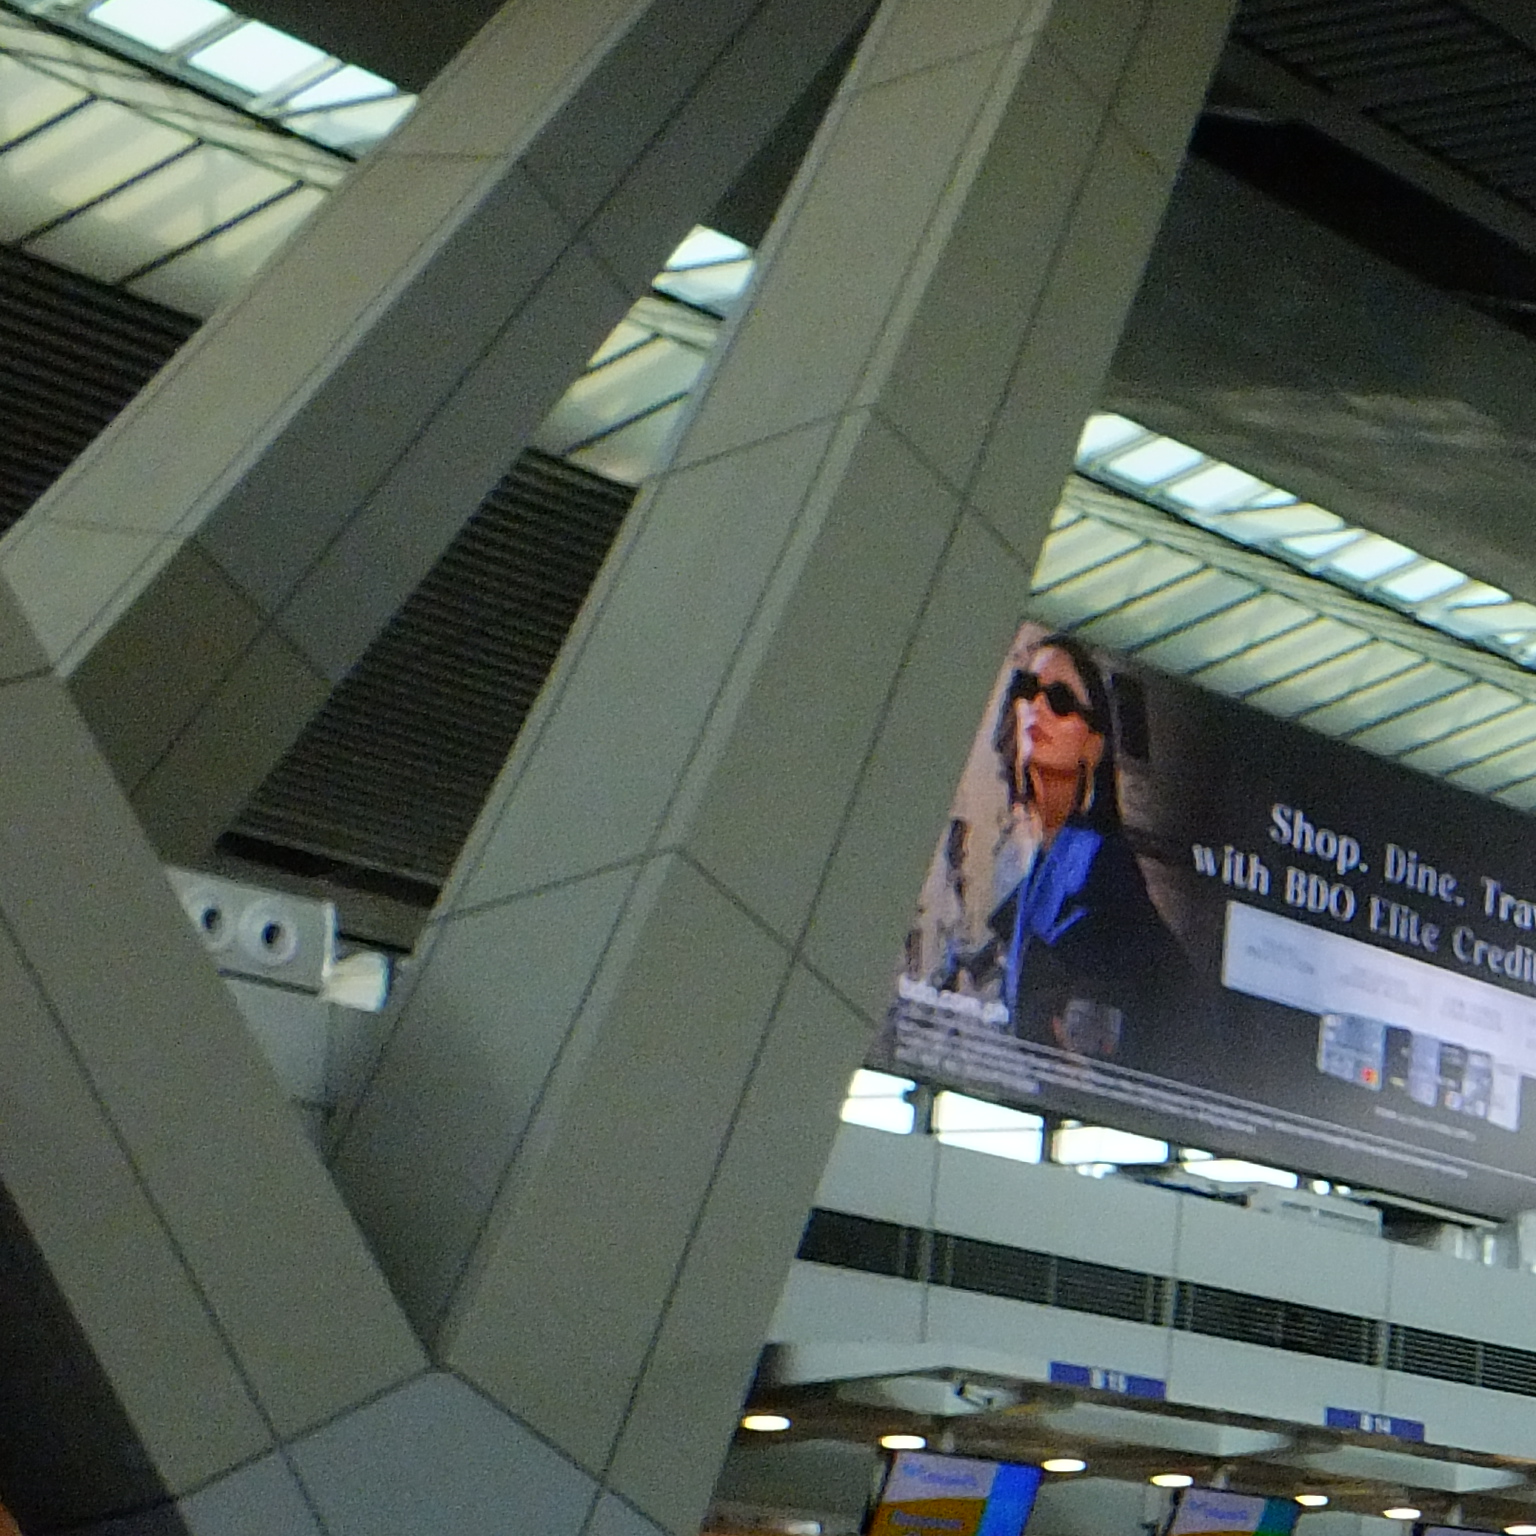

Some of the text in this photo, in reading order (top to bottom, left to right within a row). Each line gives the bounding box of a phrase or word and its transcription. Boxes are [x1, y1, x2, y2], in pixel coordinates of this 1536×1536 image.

[1192, 843, 1270, 896] with
[1286, 866, 1355, 922] BDO
[1366, 894, 1440, 953] Elite
[1269, 803, 1369, 876] Shop.
[1384, 842, 1466, 908] Dine.
